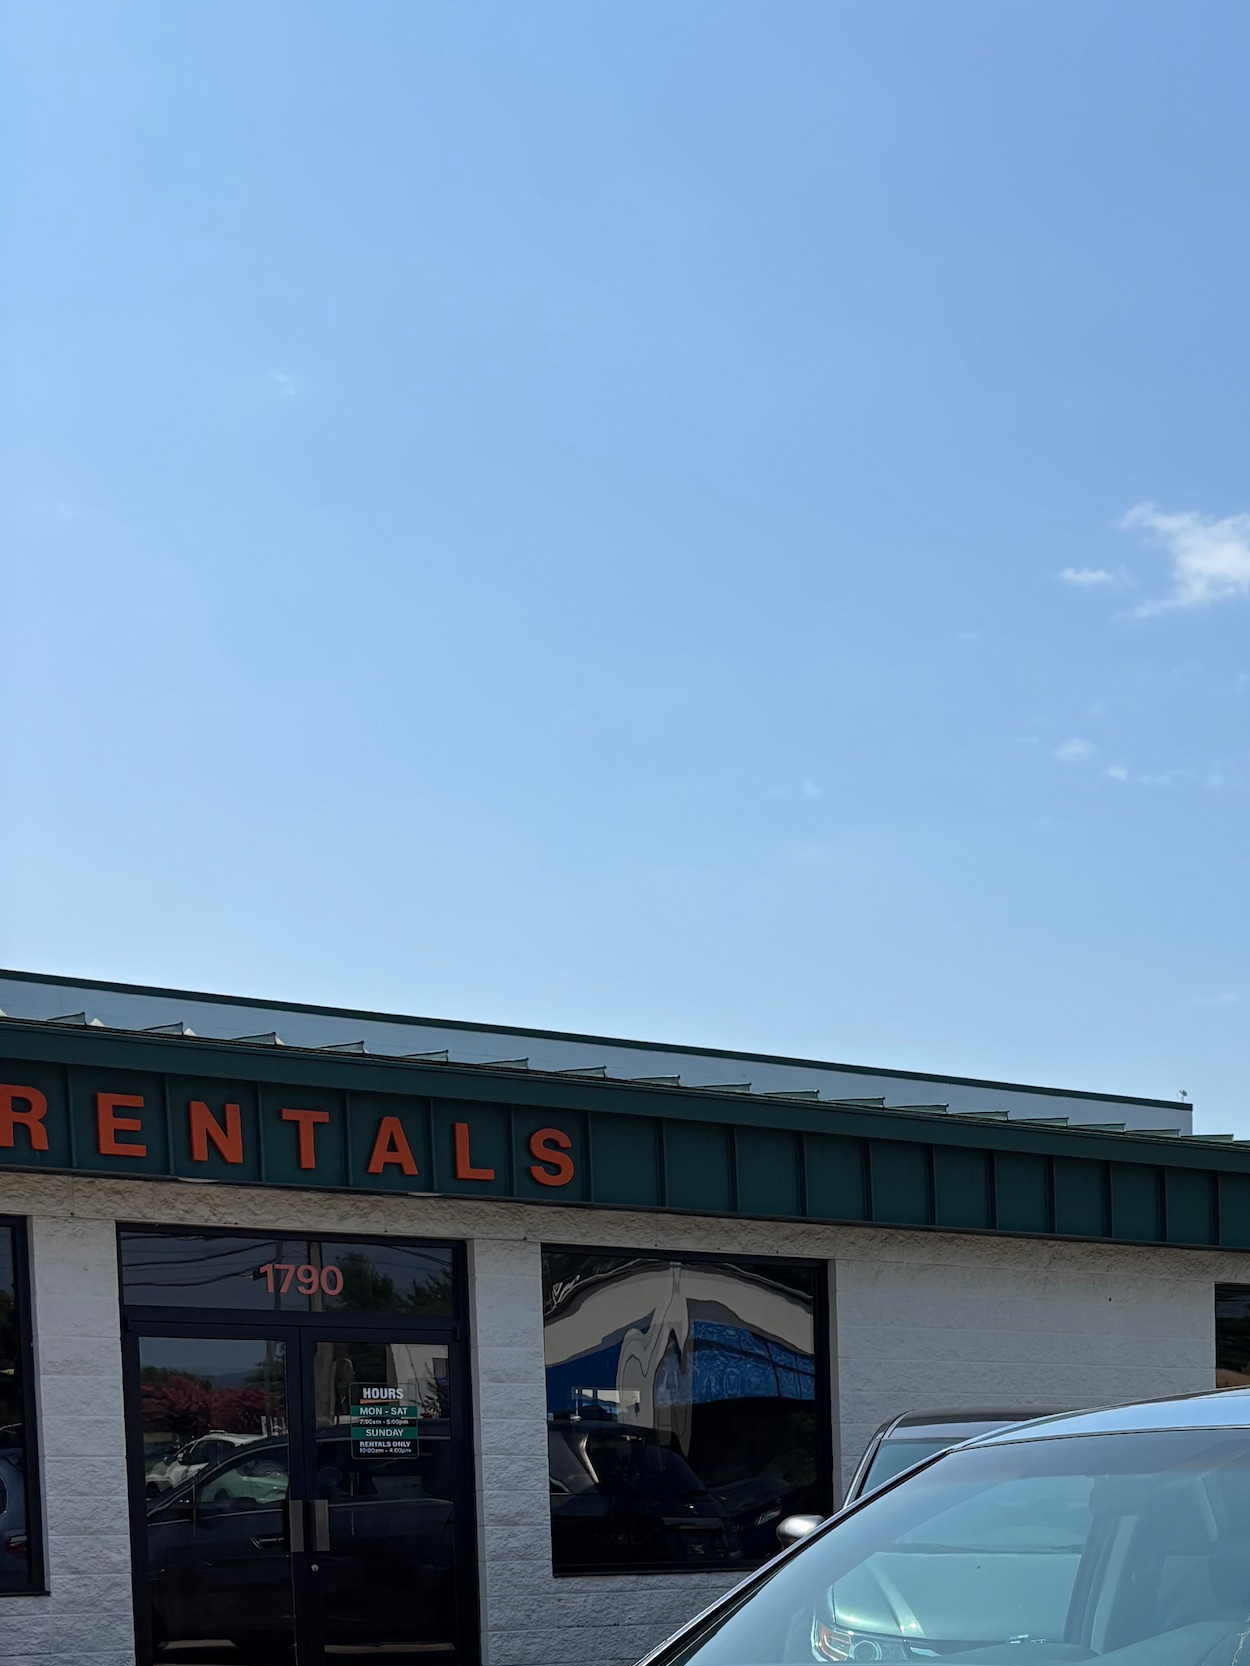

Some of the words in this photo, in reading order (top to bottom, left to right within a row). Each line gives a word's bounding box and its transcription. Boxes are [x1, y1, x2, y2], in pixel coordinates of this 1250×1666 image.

[0, 1084, 576, 1187] RENTALS
[259, 1263, 344, 1296] 1790
[362, 1387, 404, 1399] HOURS
[360, 1407, 383, 1415] MON
[390, 1407, 408, 1415] SAT
[365, 1428, 404, 1437] SUNDAY
